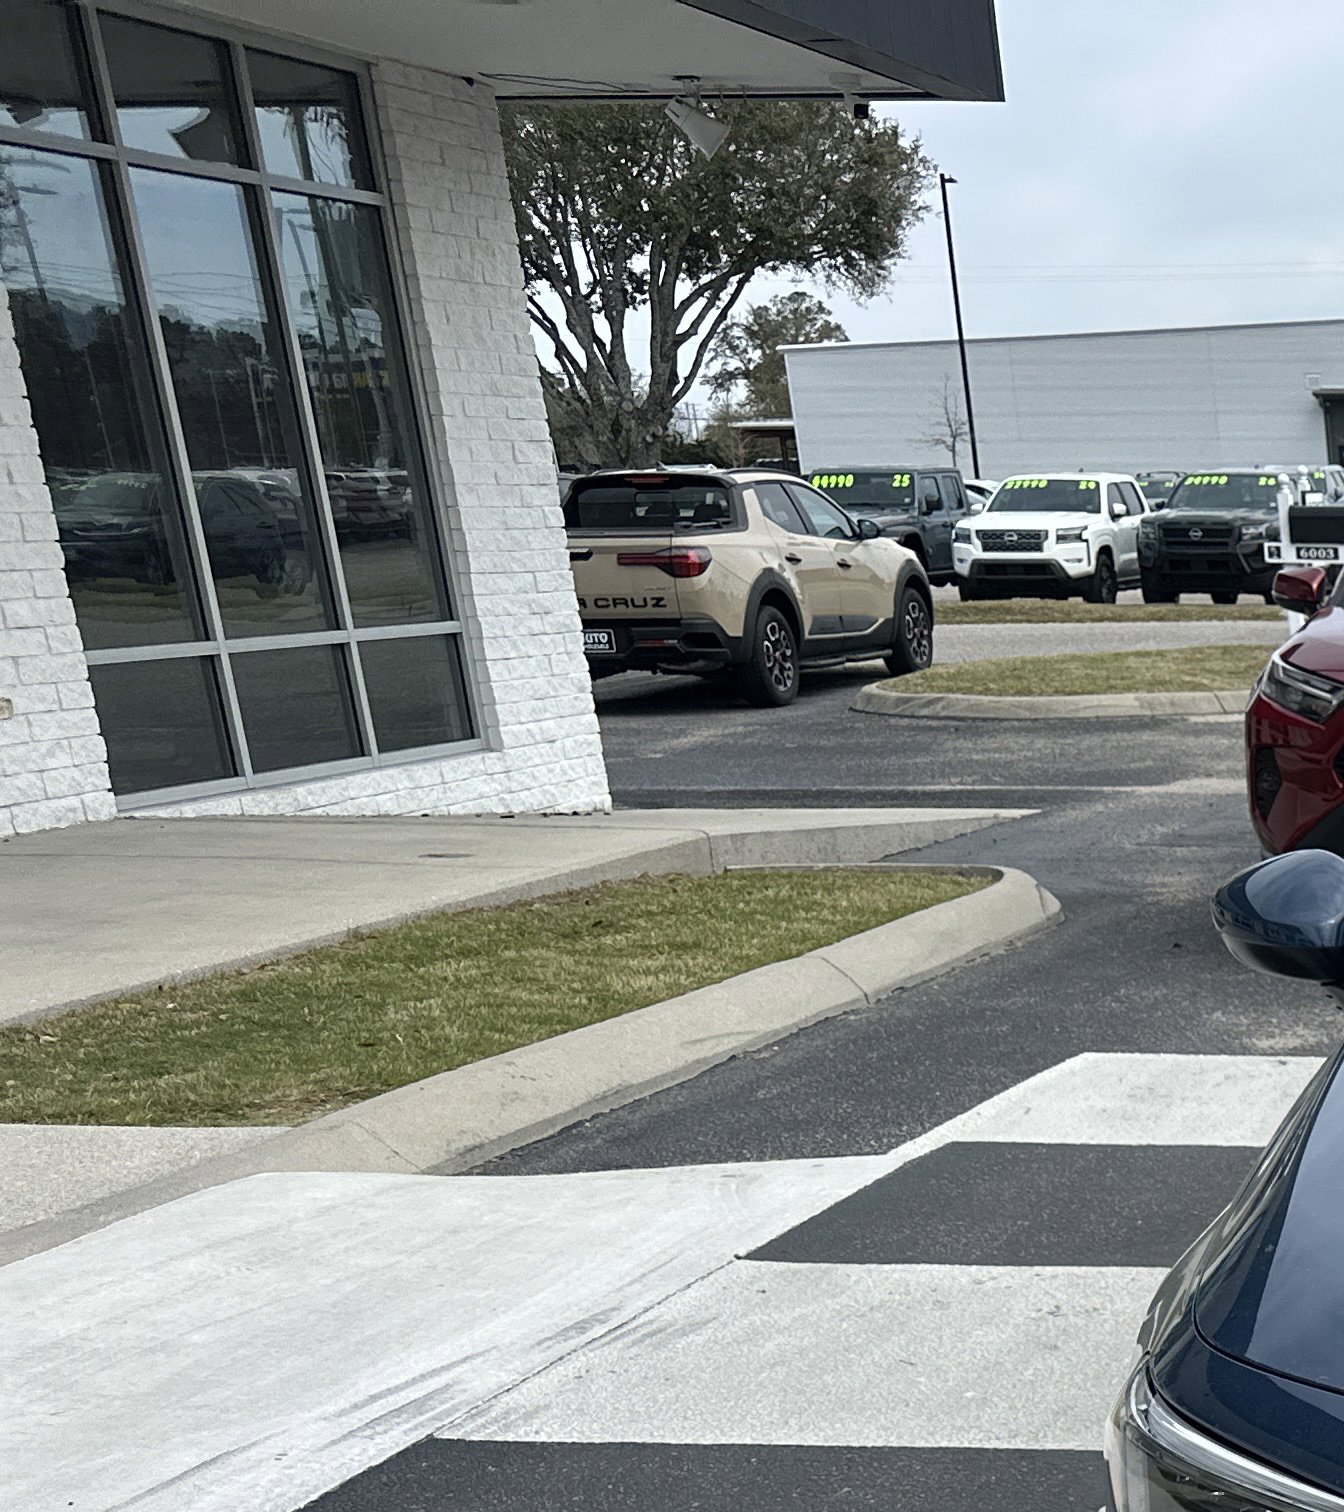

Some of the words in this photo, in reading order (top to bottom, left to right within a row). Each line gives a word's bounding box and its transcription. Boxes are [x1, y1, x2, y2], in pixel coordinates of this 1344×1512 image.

[892, 474, 910, 488] 25
[1299, 549, 1335, 559] 6003
[594, 596, 668, 609] CRUZ
[585, 632, 609, 644] UTO
